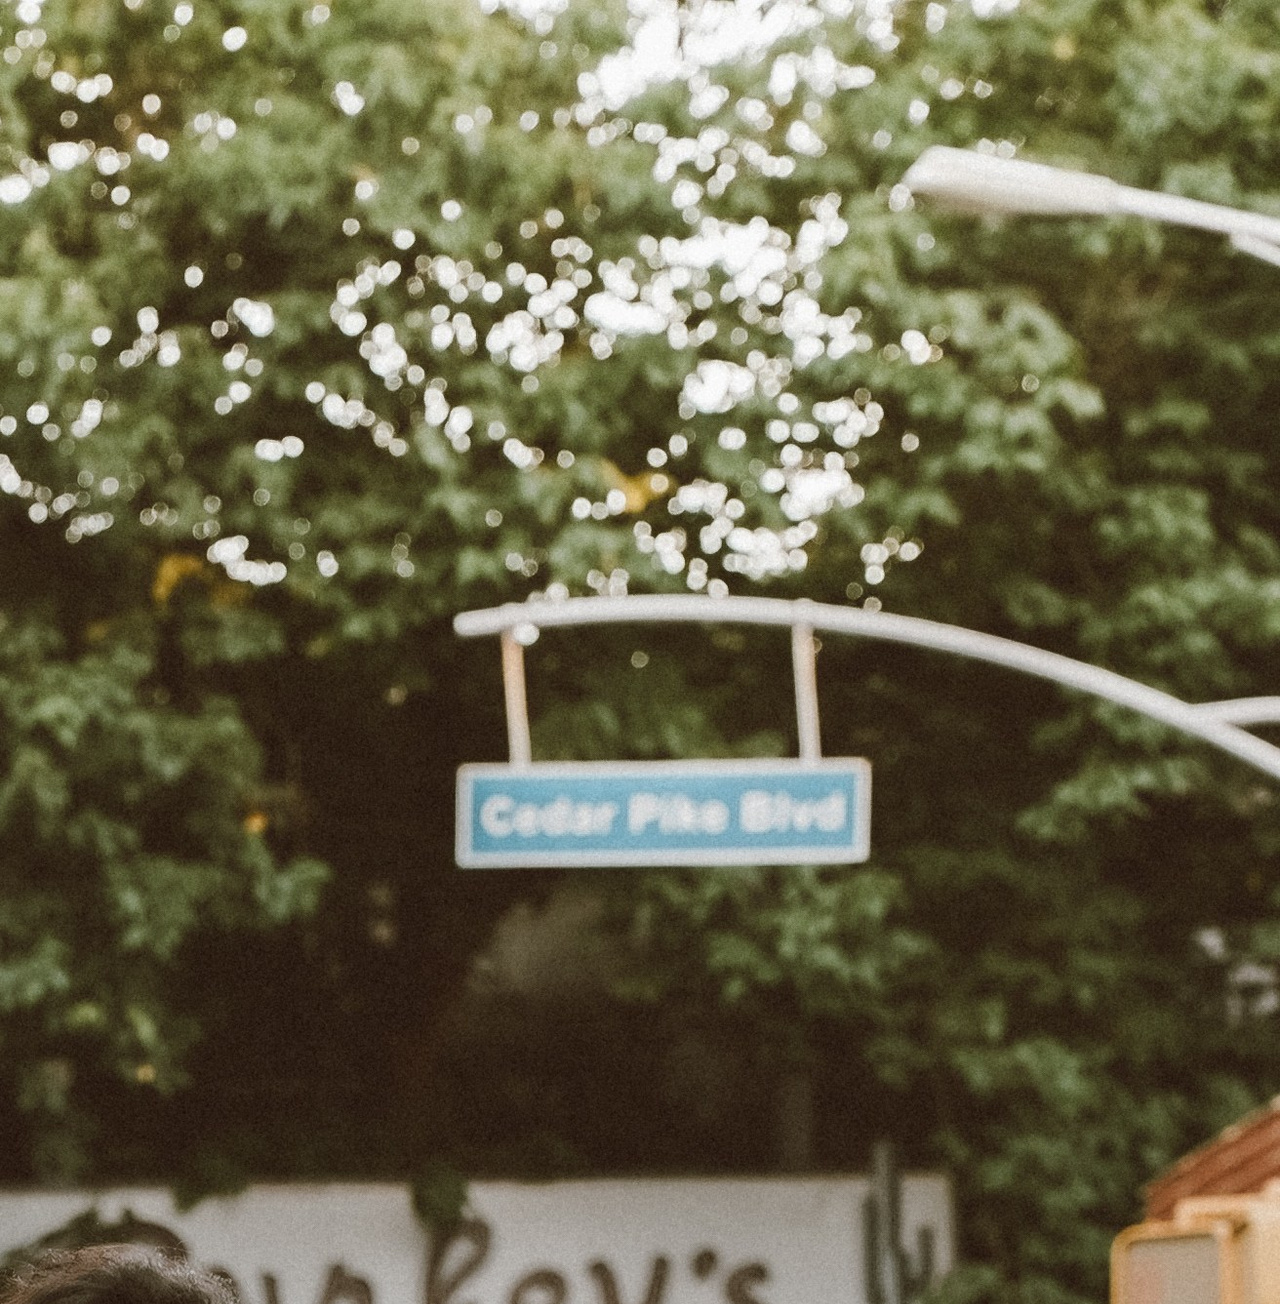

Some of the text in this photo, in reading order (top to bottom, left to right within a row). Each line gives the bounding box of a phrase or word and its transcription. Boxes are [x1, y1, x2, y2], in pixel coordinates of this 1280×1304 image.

[480, 789, 847, 838] Cedar Pike Blvd
